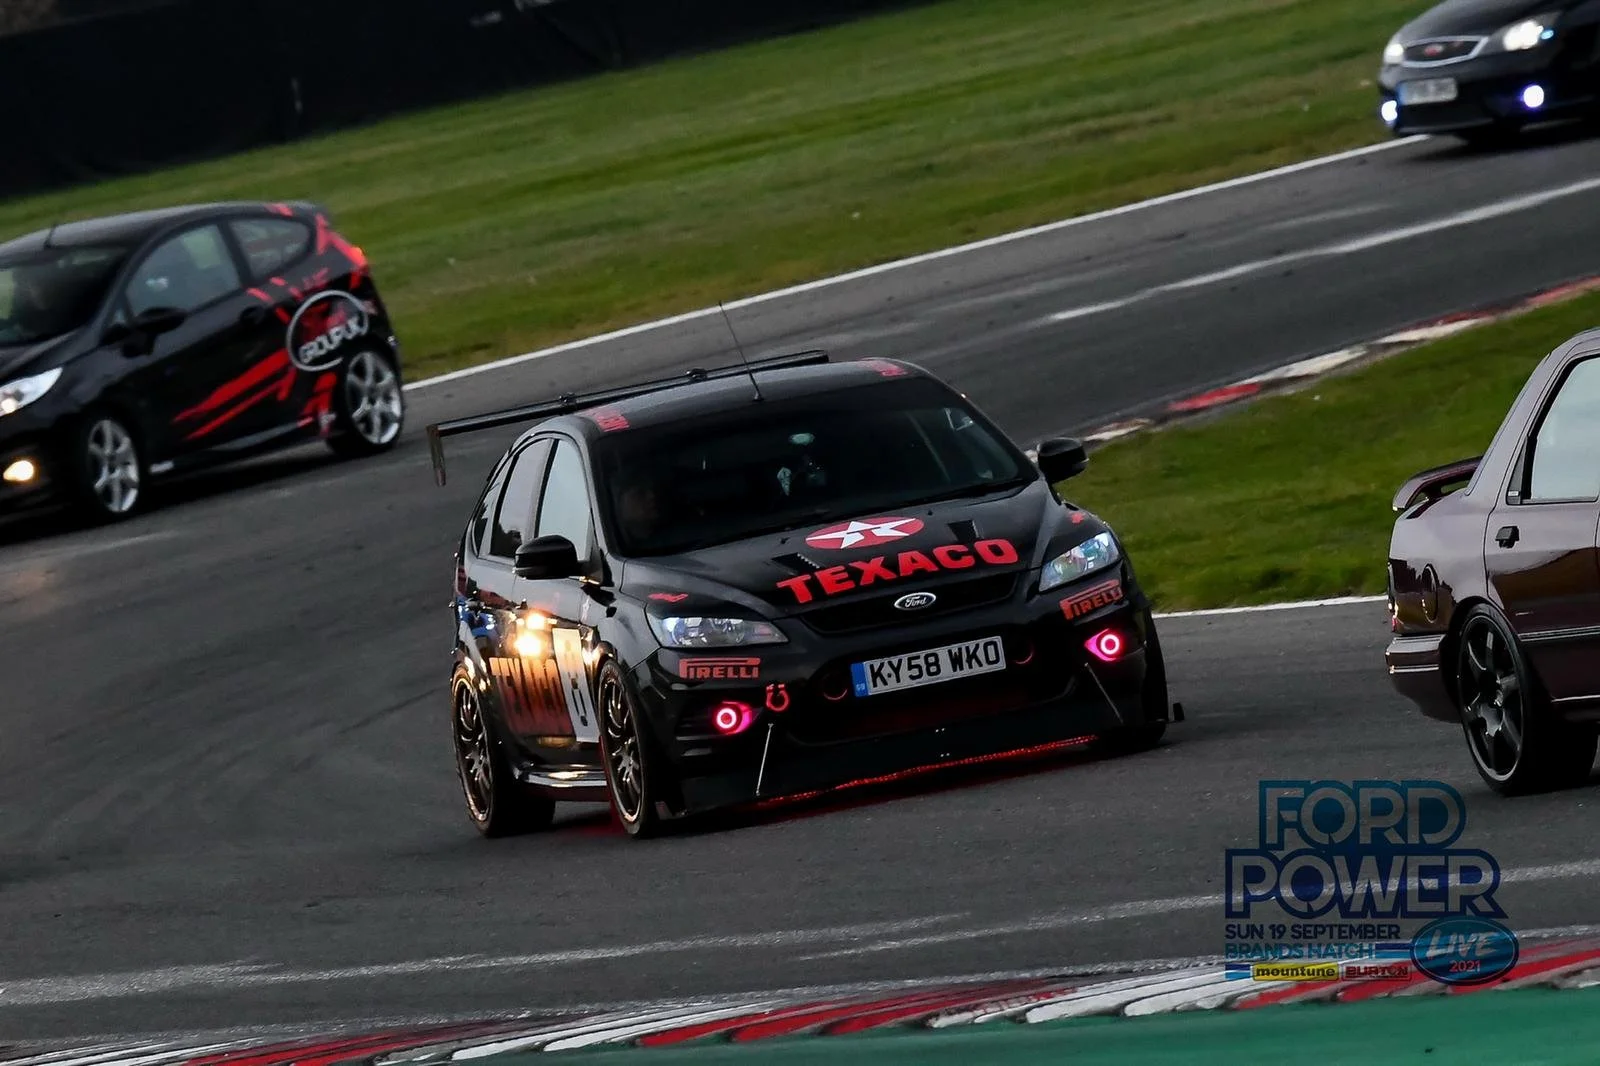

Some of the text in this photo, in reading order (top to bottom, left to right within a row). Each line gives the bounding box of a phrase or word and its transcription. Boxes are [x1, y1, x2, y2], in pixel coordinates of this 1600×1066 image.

[776, 538, 1020, 605] TEXACO
[904, 596, 928, 608] Ford
[1059, 579, 1123, 620] PIRELLI
[679, 657, 761, 679] PIRELLI
[869, 641, 1000, 688] KY58 WKO
